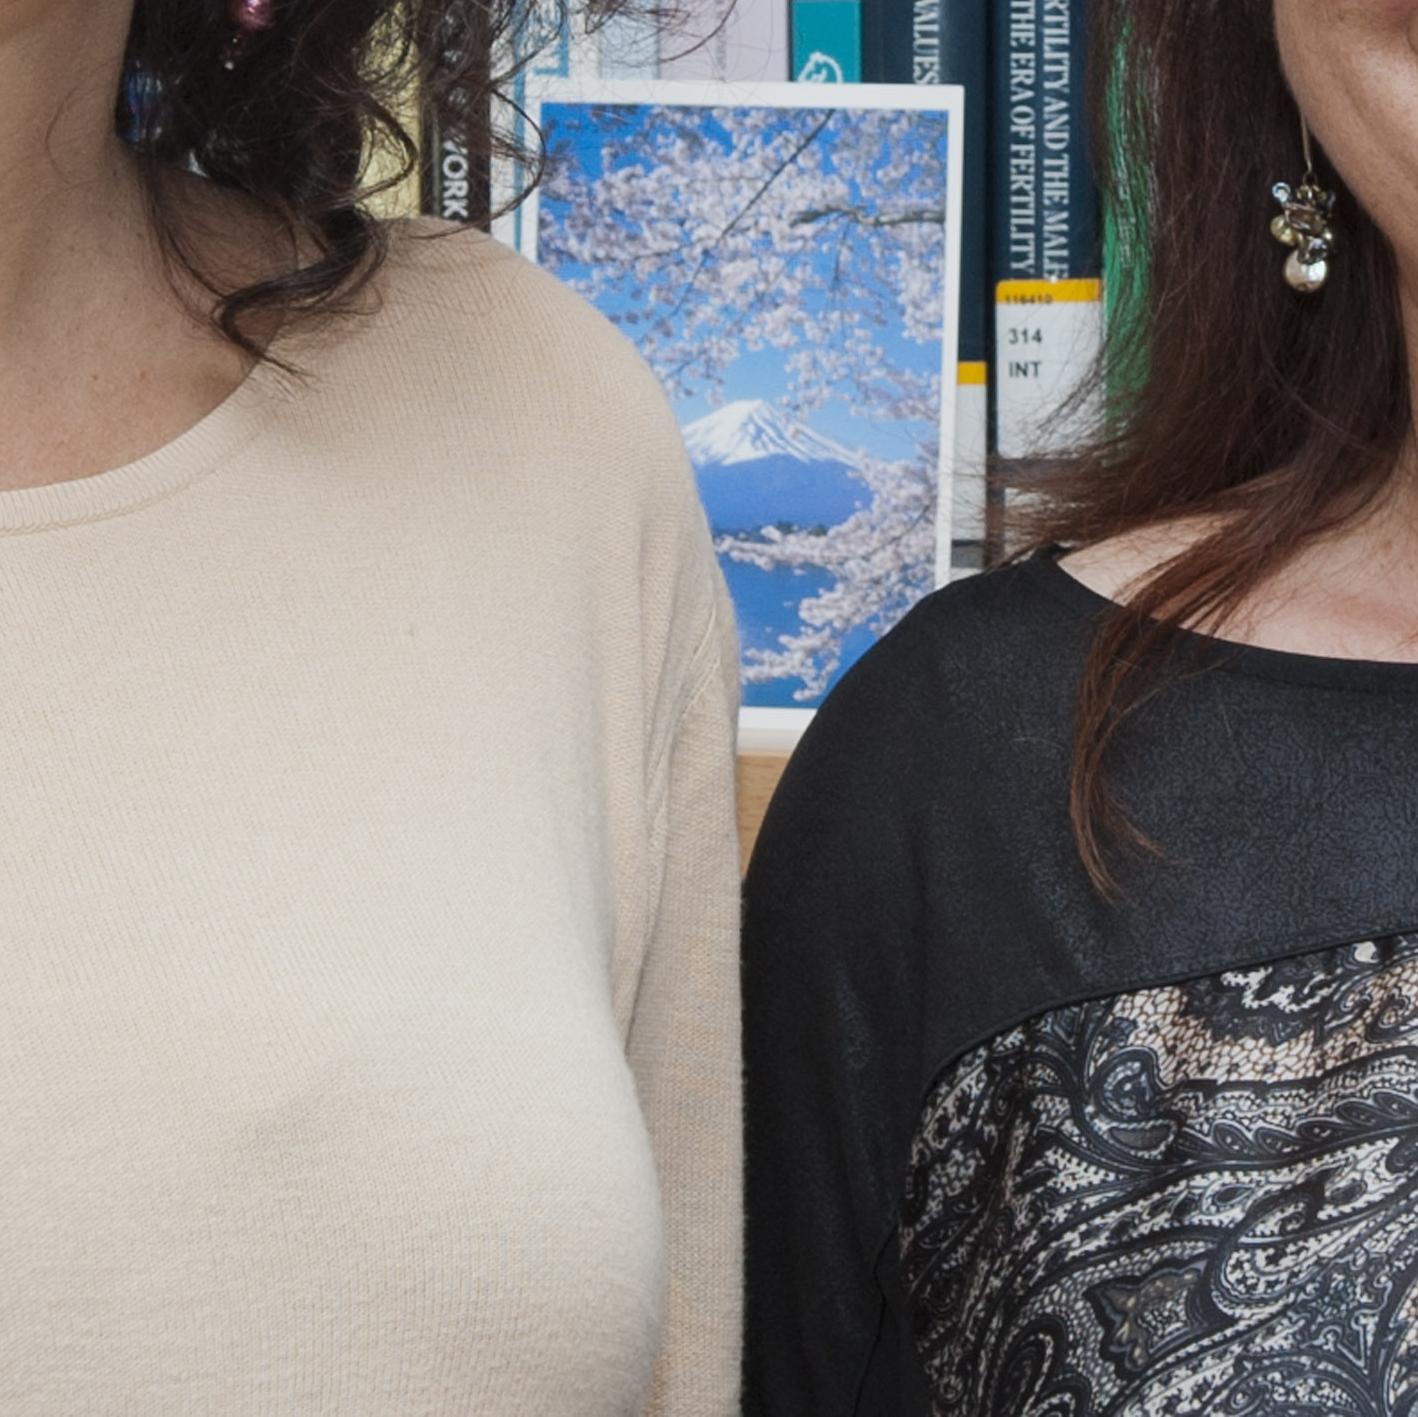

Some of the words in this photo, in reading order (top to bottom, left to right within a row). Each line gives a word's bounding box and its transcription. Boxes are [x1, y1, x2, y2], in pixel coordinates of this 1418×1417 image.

[1009, 51, 1036, 102] ERA
[1009, 105, 1036, 138] OF
[1043, 96, 1070, 150] AND
[1043, 153, 1070, 206] THE
[1009, 143, 1036, 275] FERTILITY
[1043, 210, 1070, 278] MALE
[1008, 328, 1043, 344] 314
[1008, 361, 1042, 378] INT
